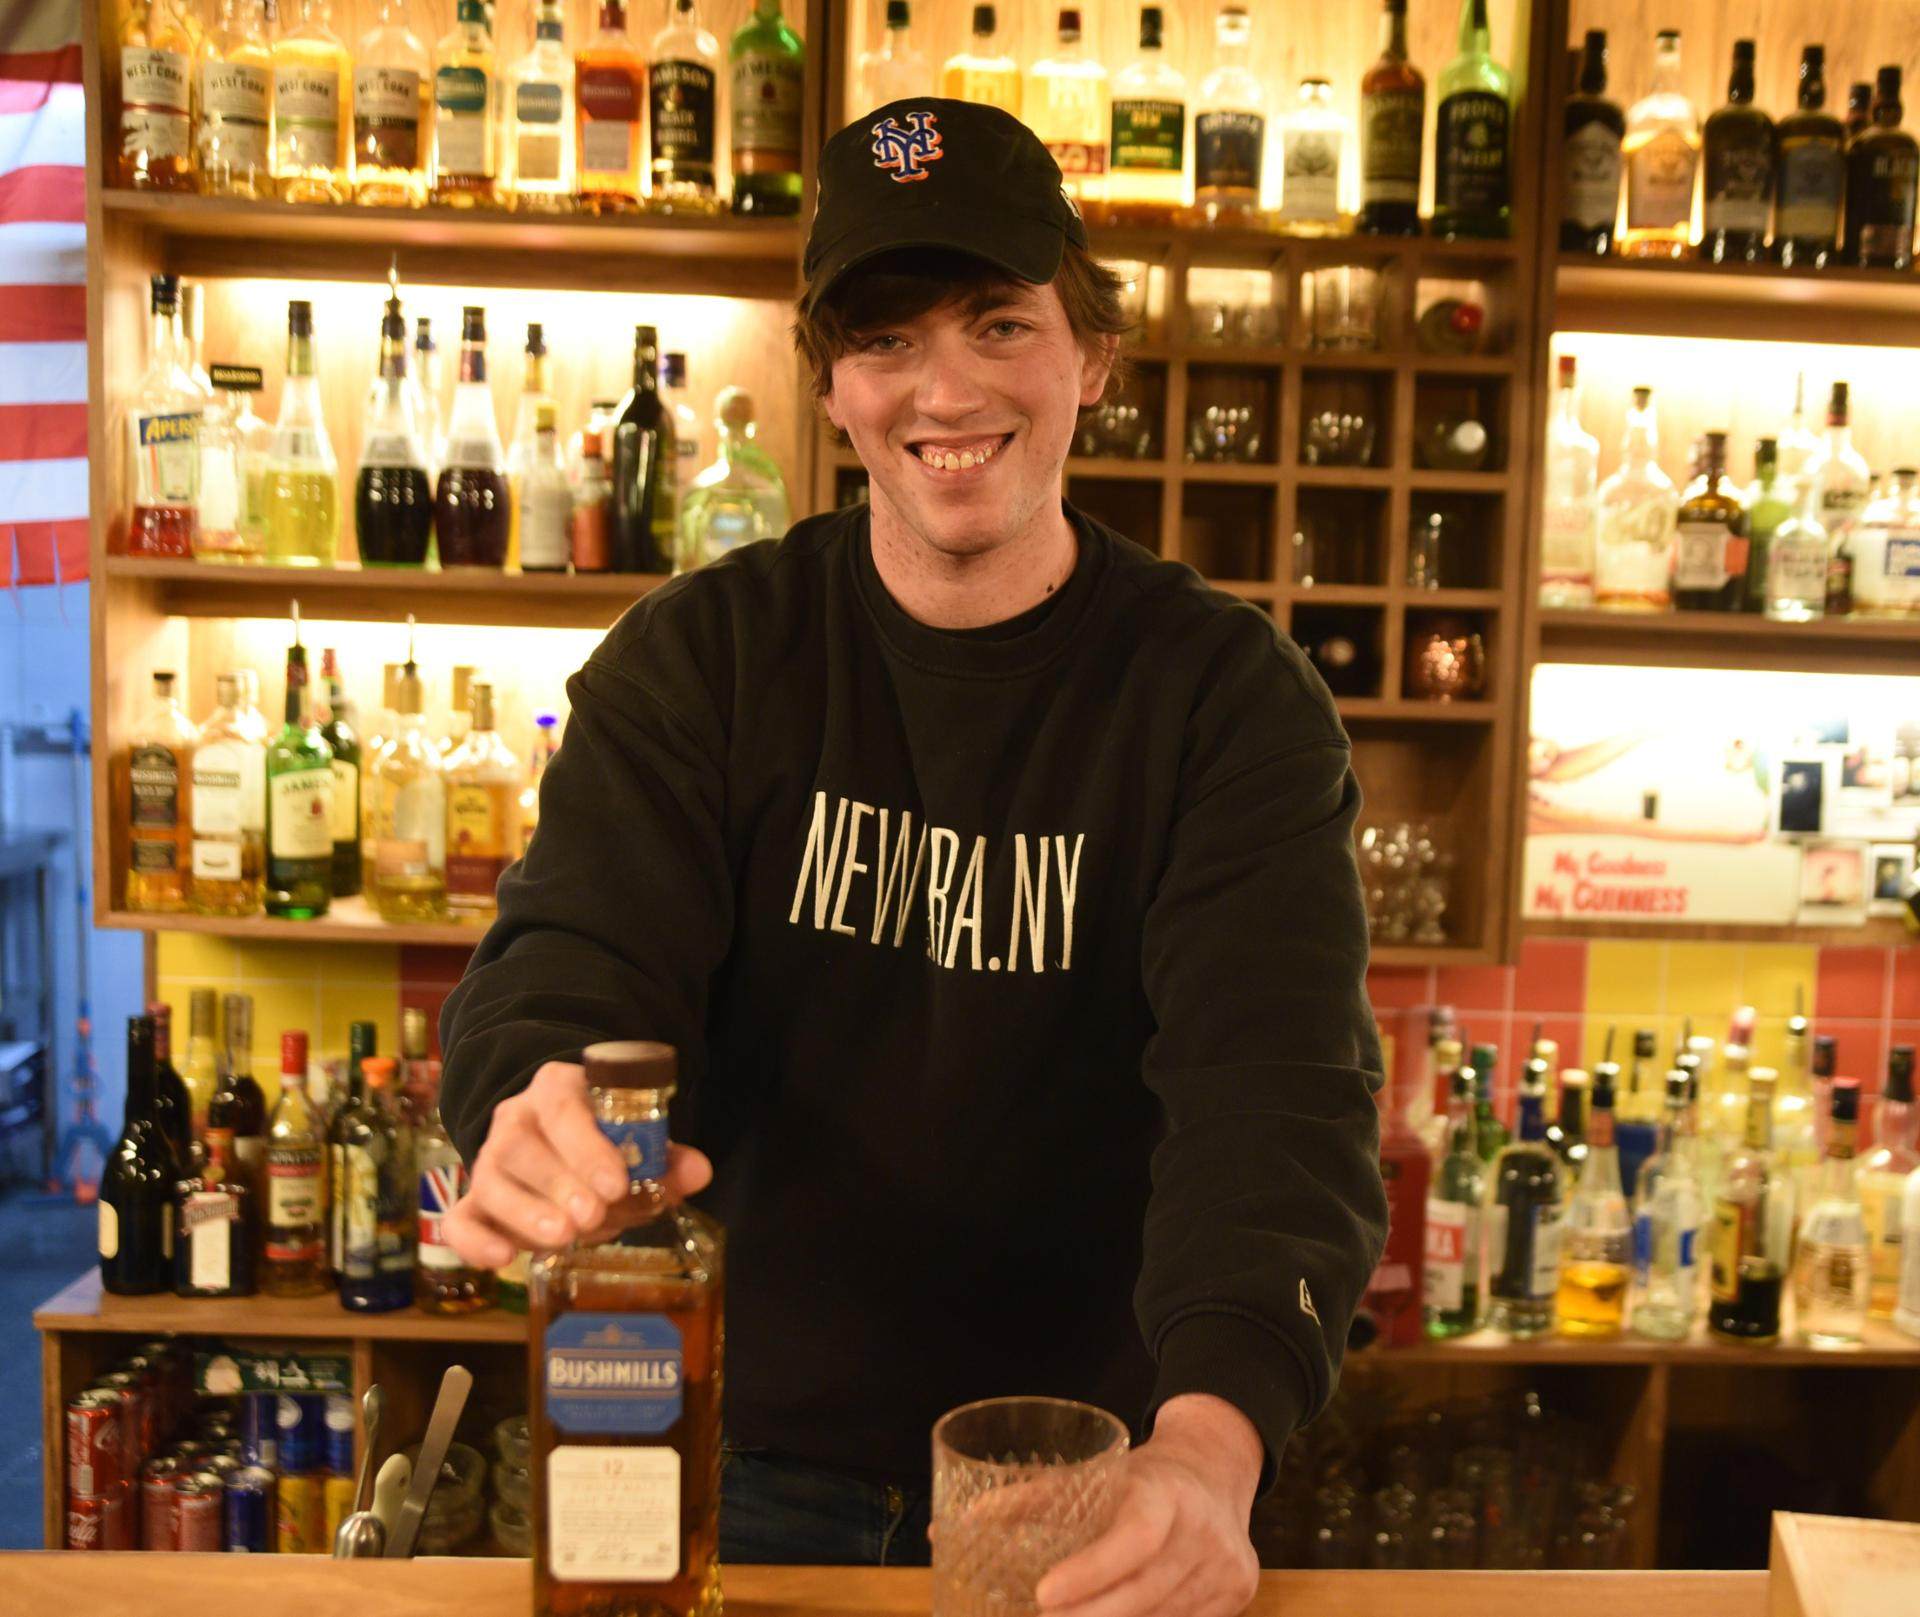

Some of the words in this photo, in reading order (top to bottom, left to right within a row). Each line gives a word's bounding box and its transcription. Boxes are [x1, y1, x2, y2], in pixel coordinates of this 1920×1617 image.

[871, 111, 943, 183] NY
[1535, 882, 1564, 918] My
[1573, 879, 1689, 914] GUINNESS
[548, 1356, 678, 1389] BUSHMILLS
